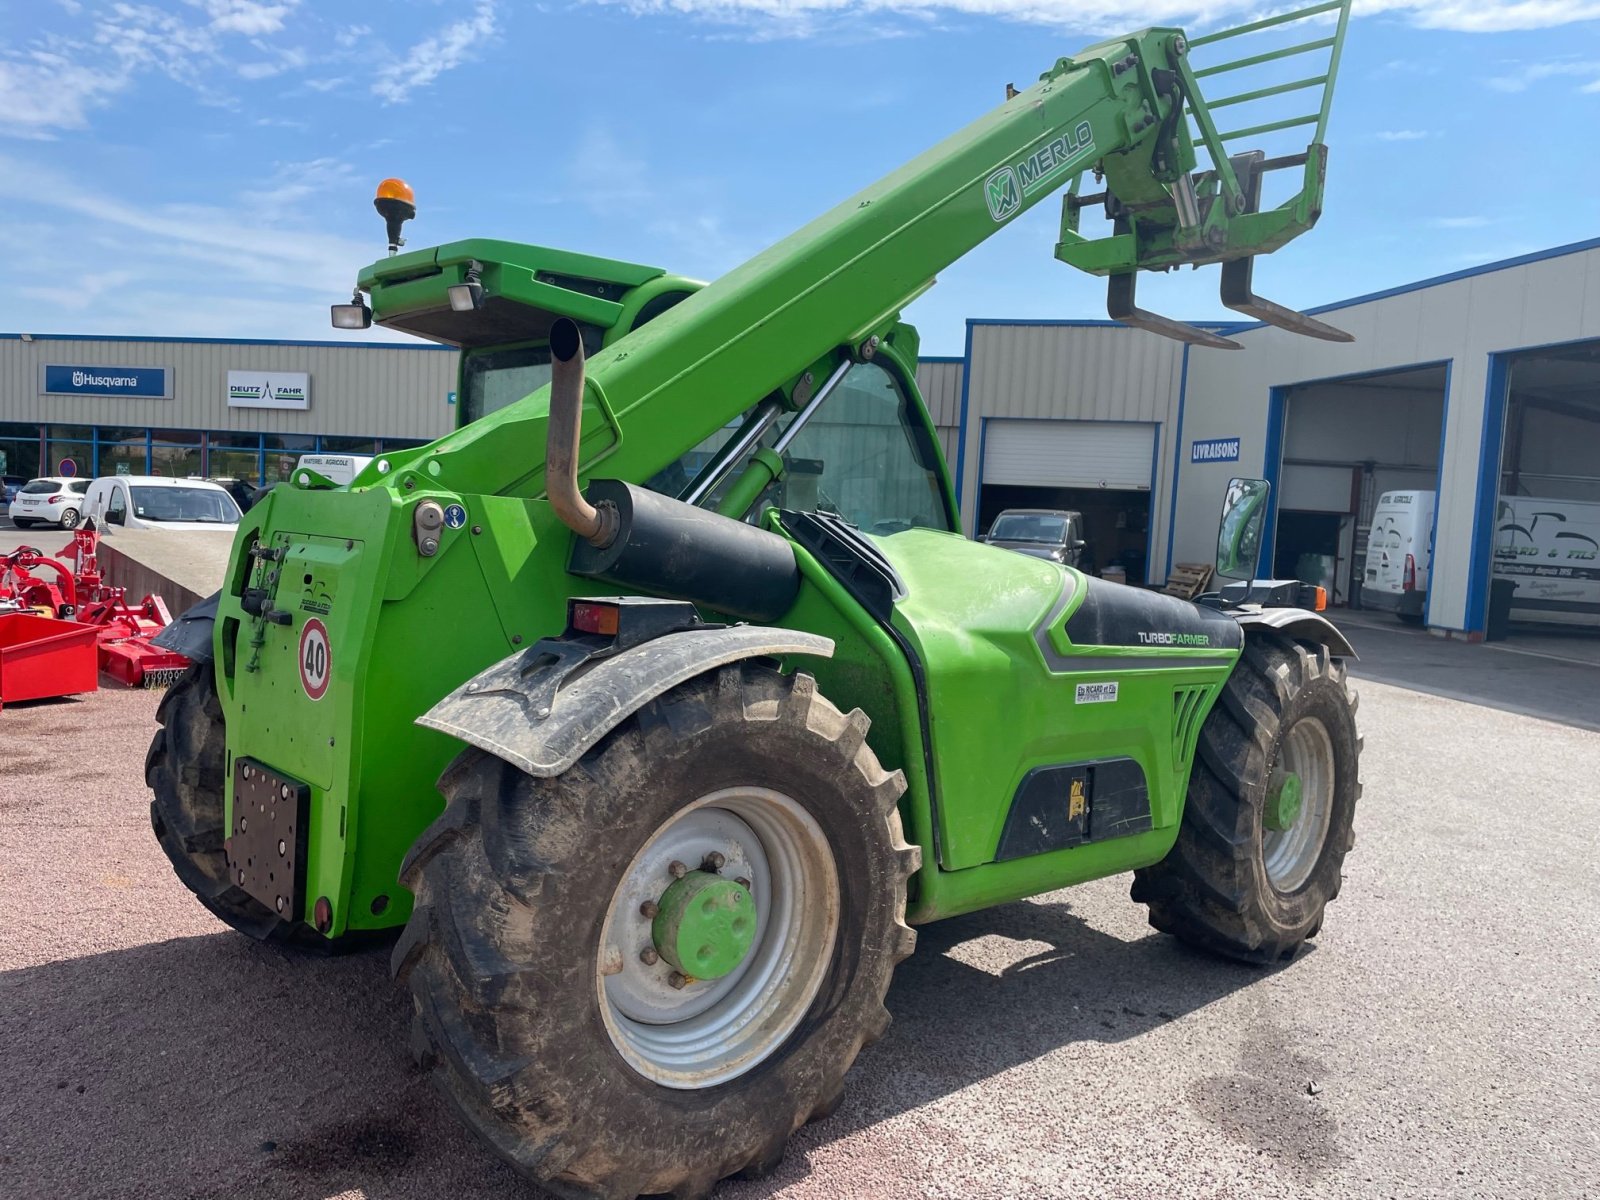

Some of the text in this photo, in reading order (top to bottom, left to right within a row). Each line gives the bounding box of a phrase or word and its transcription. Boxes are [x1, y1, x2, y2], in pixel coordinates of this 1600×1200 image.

[1017, 120, 1093, 187] MERLO
[83, 375, 137, 387] Husqvarna
[1192, 442, 1239, 460] LIVRAISONS
[1393, 495, 1413, 504] AGRICOLE
[1548, 549, 1557, 558] &
[1567, 551, 1598, 560] FILS
[1138, 632, 1209, 645] TURBOFARMER
[305, 639, 325, 679] 40
[1086, 685, 1103, 694] RICARD
